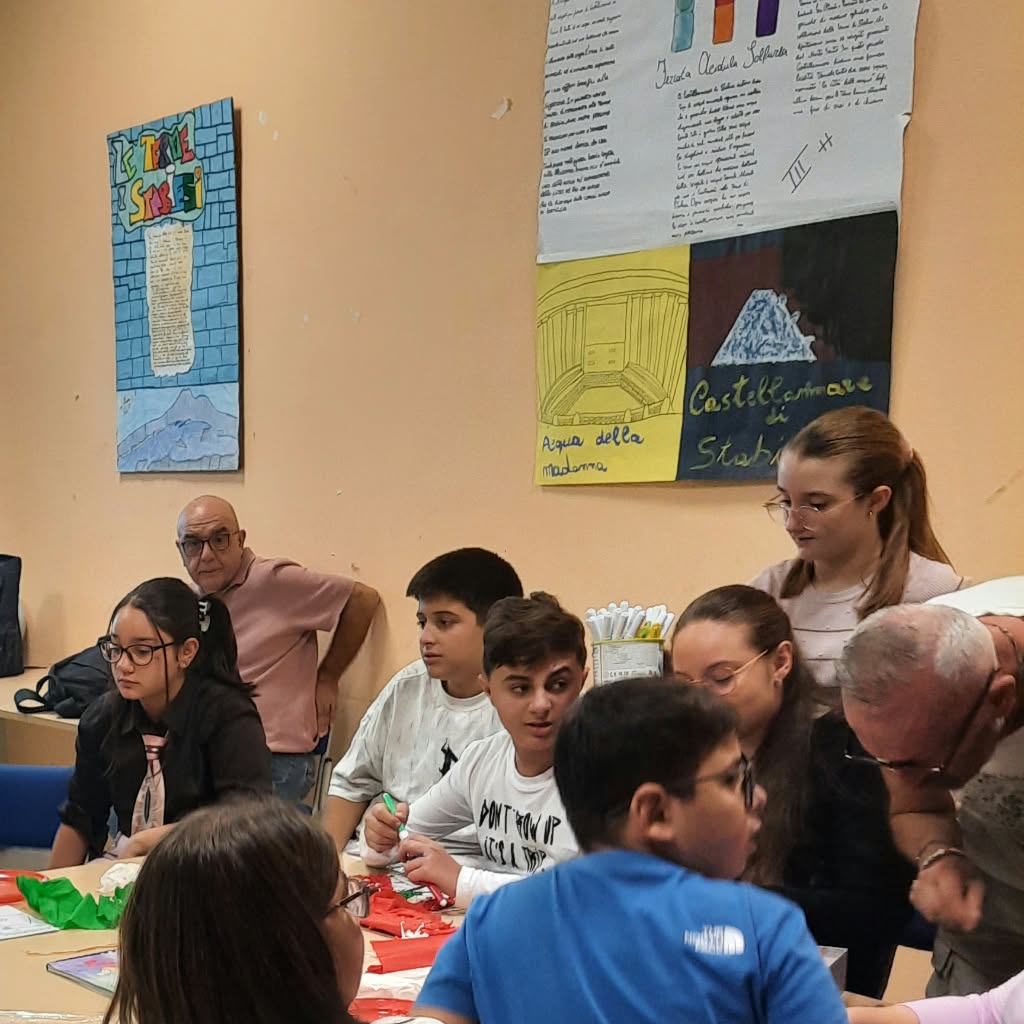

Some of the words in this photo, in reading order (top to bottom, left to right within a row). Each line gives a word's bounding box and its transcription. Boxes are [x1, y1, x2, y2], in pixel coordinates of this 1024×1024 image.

[765, 404, 790, 425] di
[596, 424, 645, 446] della
[689, 434, 782, 470] Stabi
[543, 814, 562, 846] UP
